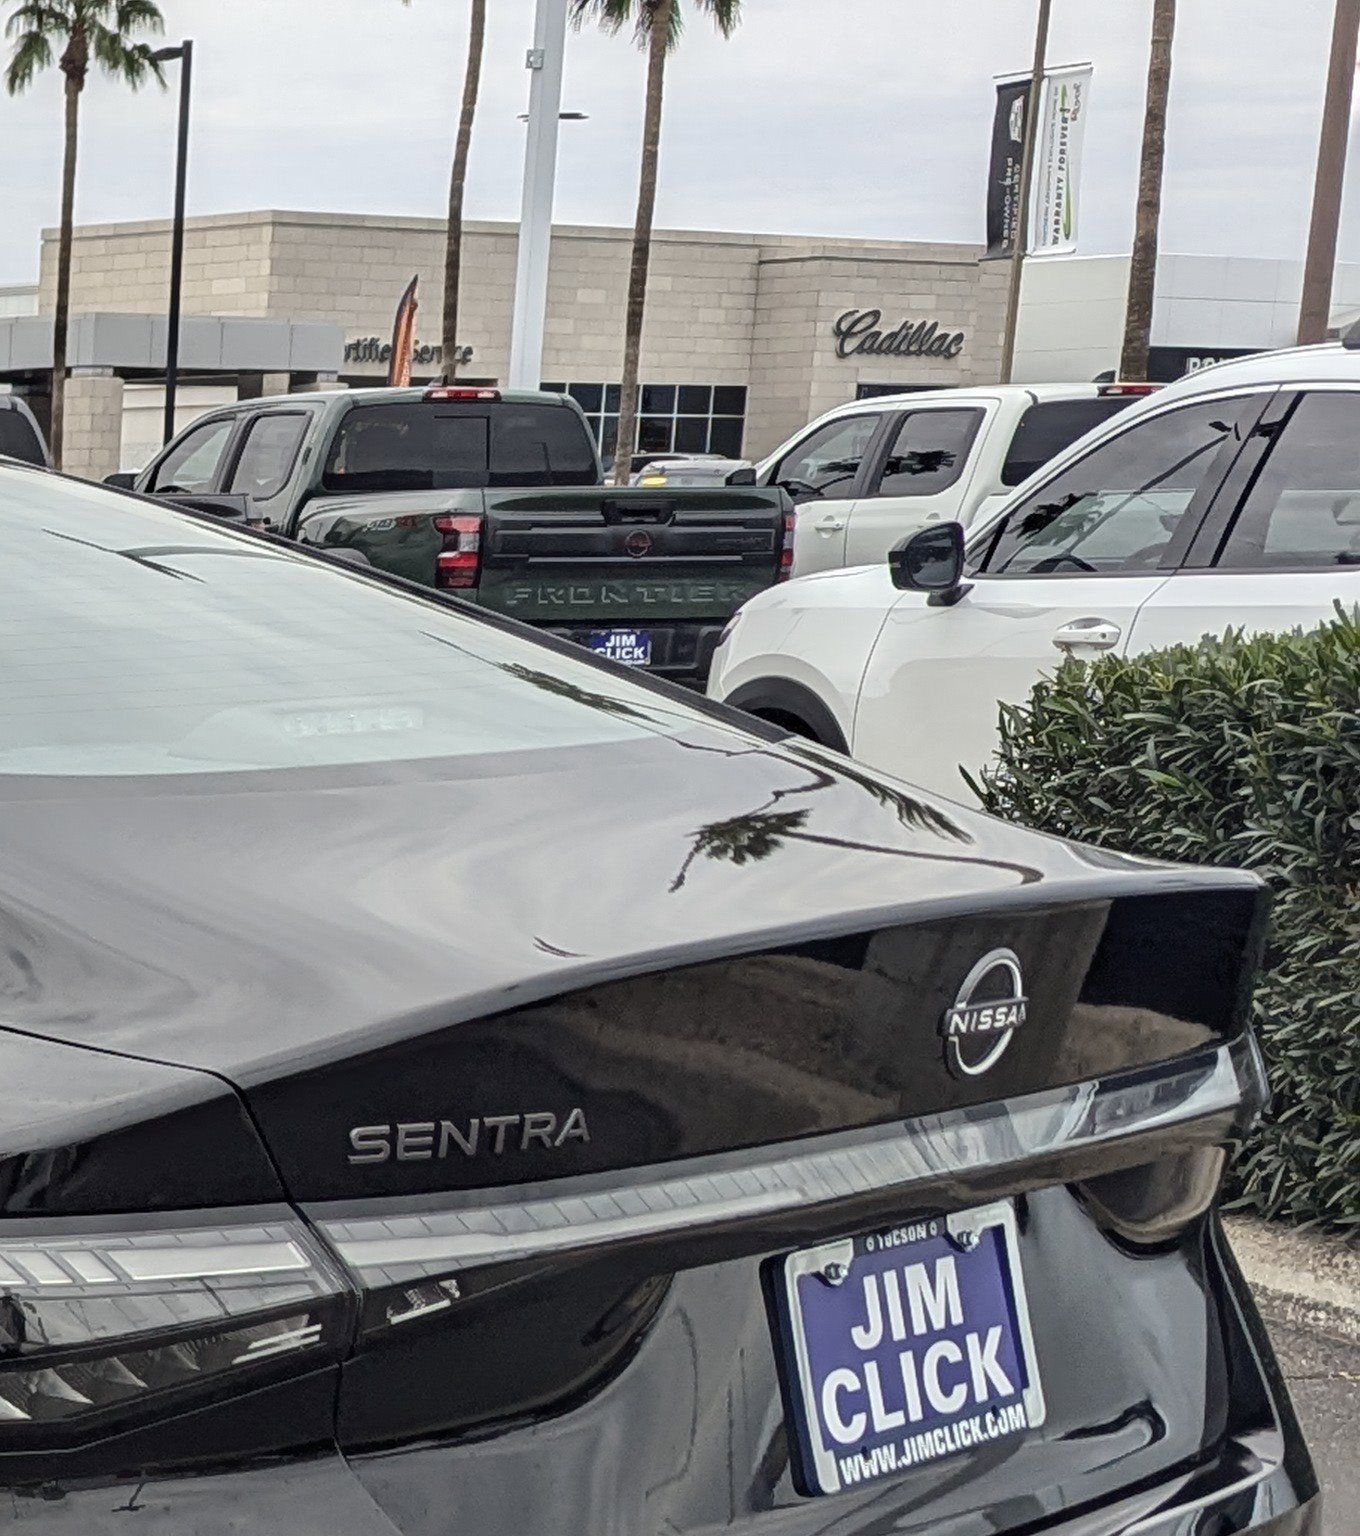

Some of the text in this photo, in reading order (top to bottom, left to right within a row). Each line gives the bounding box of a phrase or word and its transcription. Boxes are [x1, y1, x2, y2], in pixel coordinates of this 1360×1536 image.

[1051, 115, 1070, 246] WARRANTY FOREVER
[833, 309, 964, 359] Cadillac
[507, 584, 750, 605] FRONTIER
[605, 634, 637, 647] JIM
[948, 1002, 1027, 1035] NISSAN
[347, 1107, 591, 1164] SENTRA
[850, 1255, 964, 1350] JIM
[821, 1324, 1015, 1444] CLICK
[839, 1402, 1027, 1485] WWW.JIMCLICK.COM
